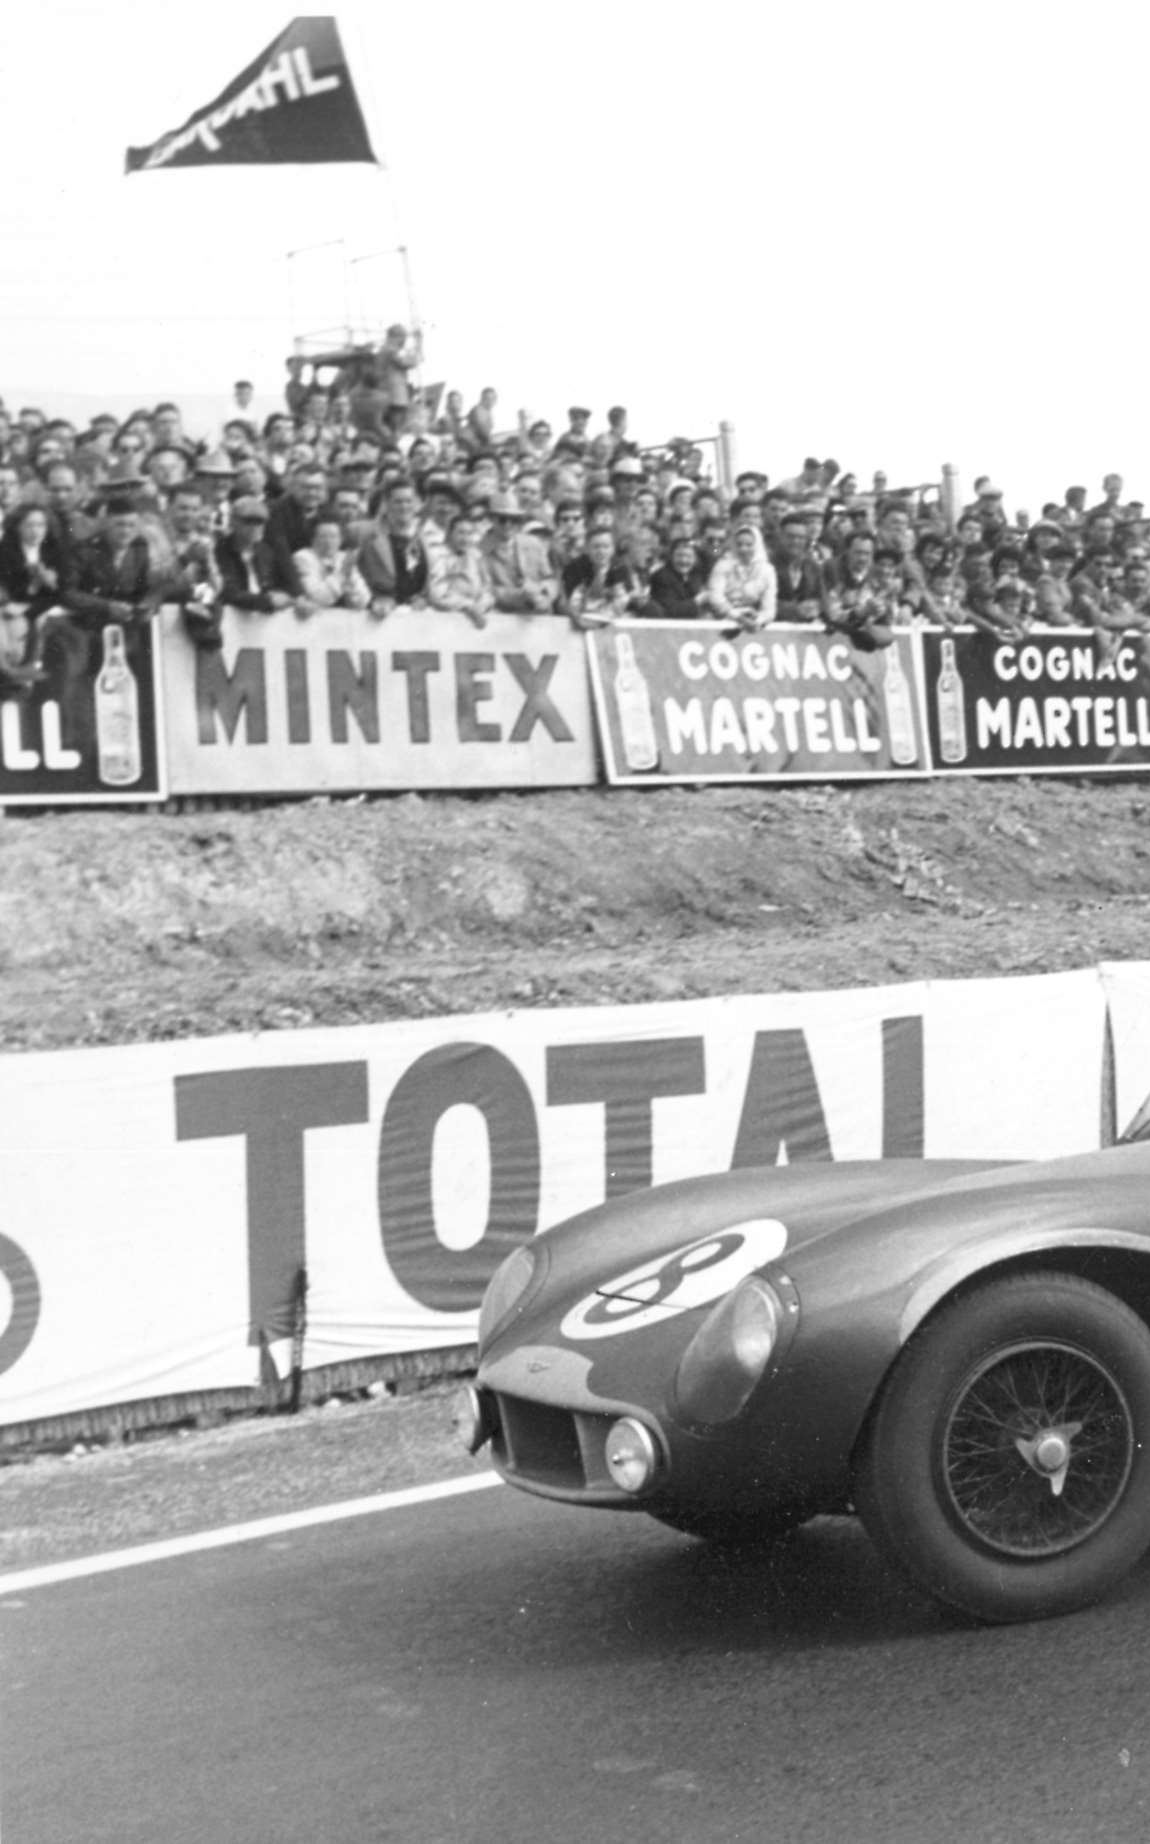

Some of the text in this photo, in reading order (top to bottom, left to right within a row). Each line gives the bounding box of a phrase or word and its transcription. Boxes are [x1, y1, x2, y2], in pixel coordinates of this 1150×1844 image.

[198, 647, 576, 746] MINTEX
[678, 640, 853, 681] COGNAC
[663, 696, 882, 754] MARTELL
[583, 1232, 746, 1325] 8
